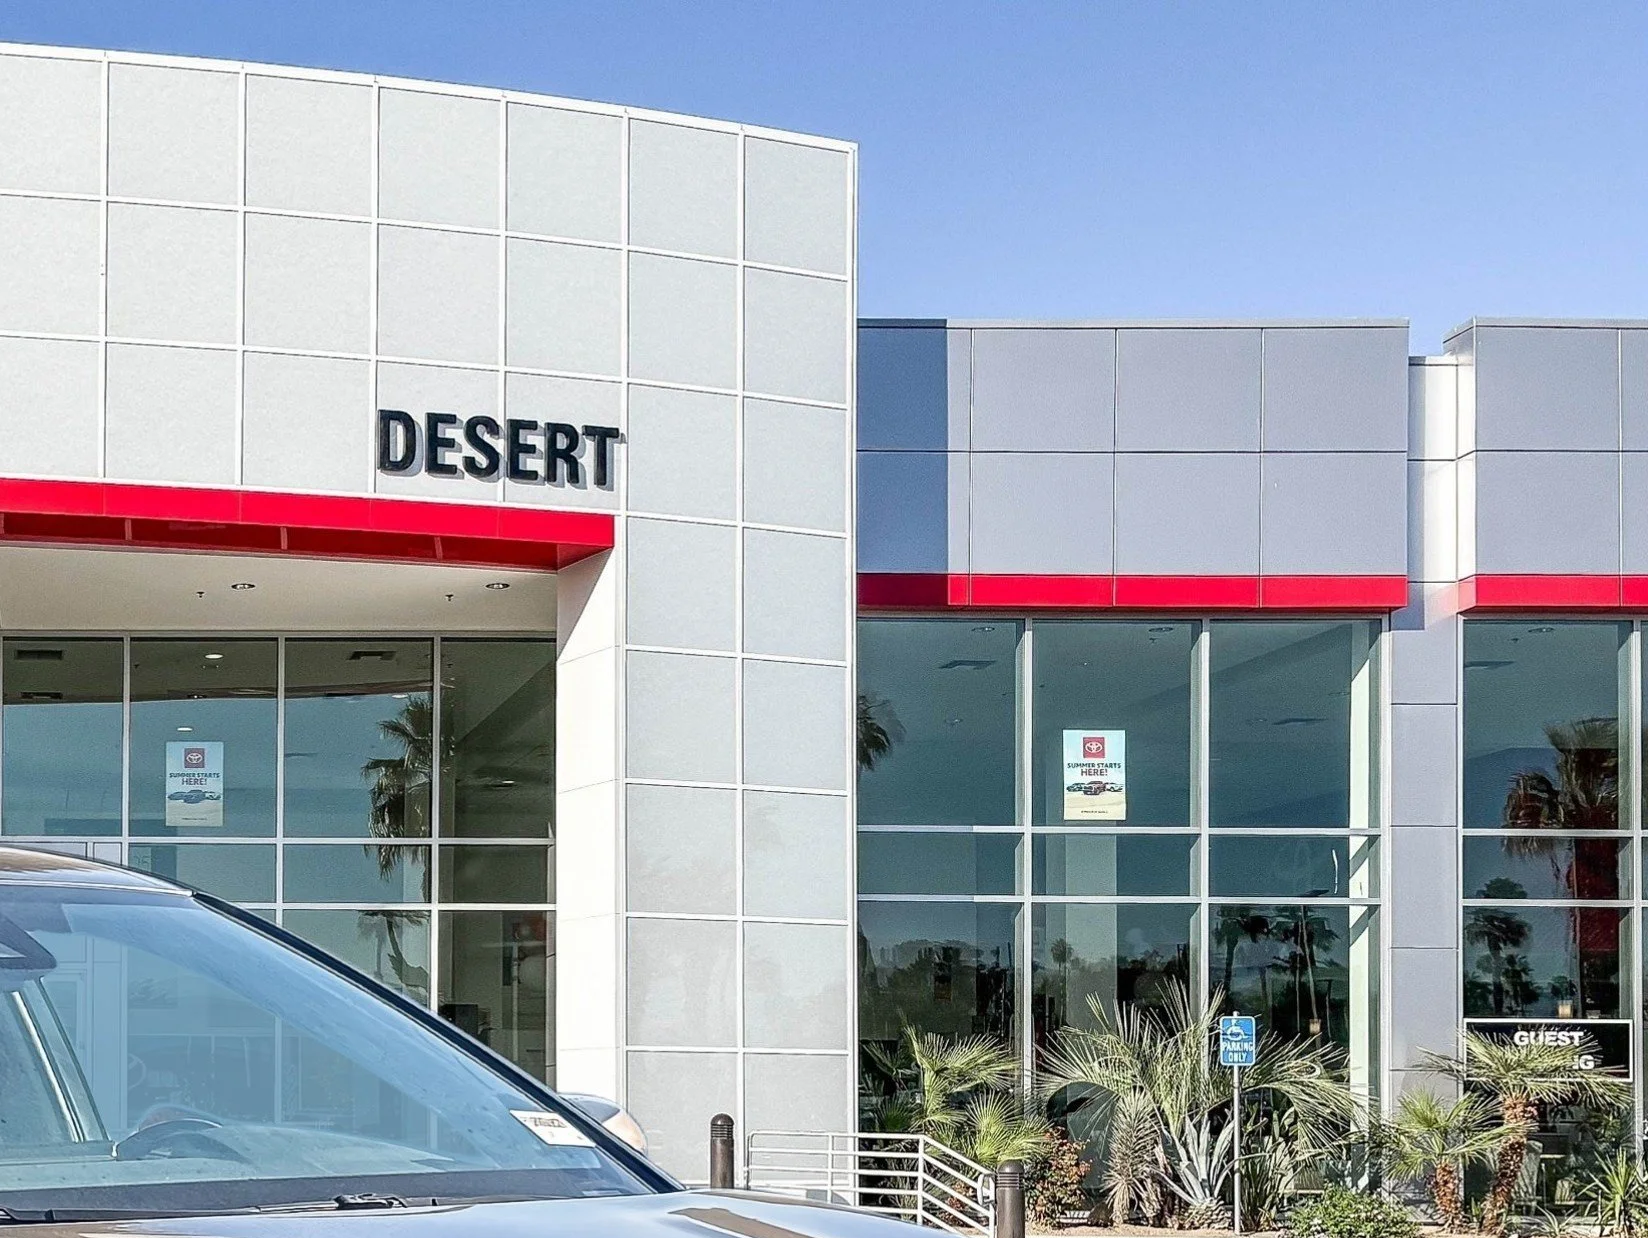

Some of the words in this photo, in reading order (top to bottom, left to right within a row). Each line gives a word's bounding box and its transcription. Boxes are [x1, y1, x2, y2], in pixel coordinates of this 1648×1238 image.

[377, 408, 620, 487] DESERT
[1080, 768, 1108, 777] HERE!
[181, 777, 208, 786] HERE!
[1513, 1030, 1584, 1047] GUEST
[1222, 1041, 1253, 1051] PARKING
[1228, 1051, 1248, 1062] ONLY
